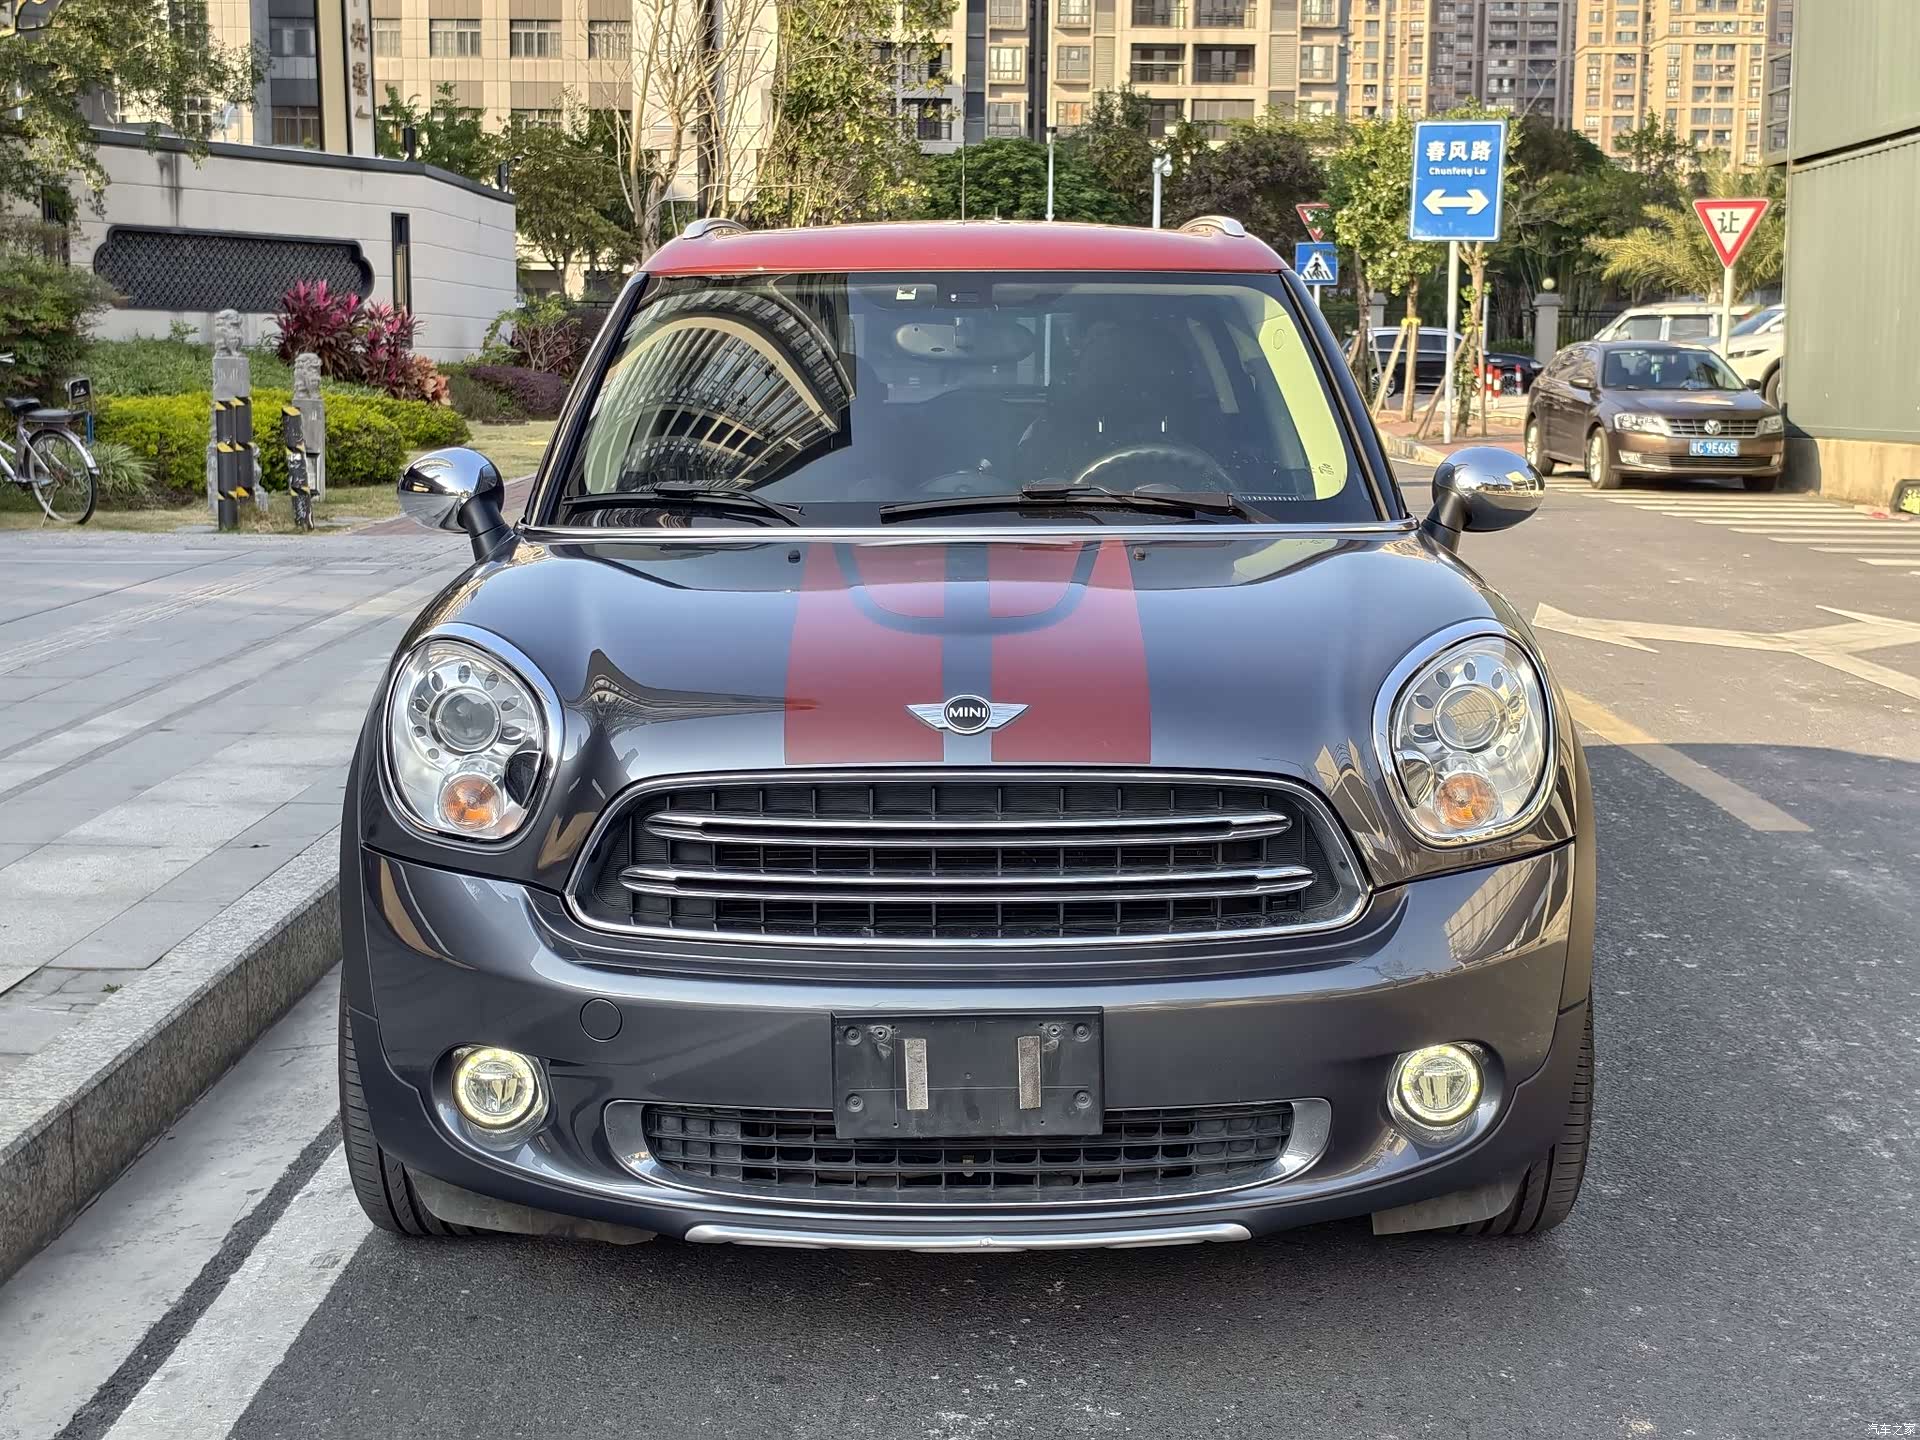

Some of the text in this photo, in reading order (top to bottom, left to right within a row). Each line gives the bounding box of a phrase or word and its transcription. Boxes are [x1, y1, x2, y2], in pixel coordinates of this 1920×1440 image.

[1426, 141, 1492, 162] 春风路
[1429, 166, 1487, 177] Chunfeng Lu
[1717, 211, 1740, 234] 让
[949, 707, 986, 718] MINI
